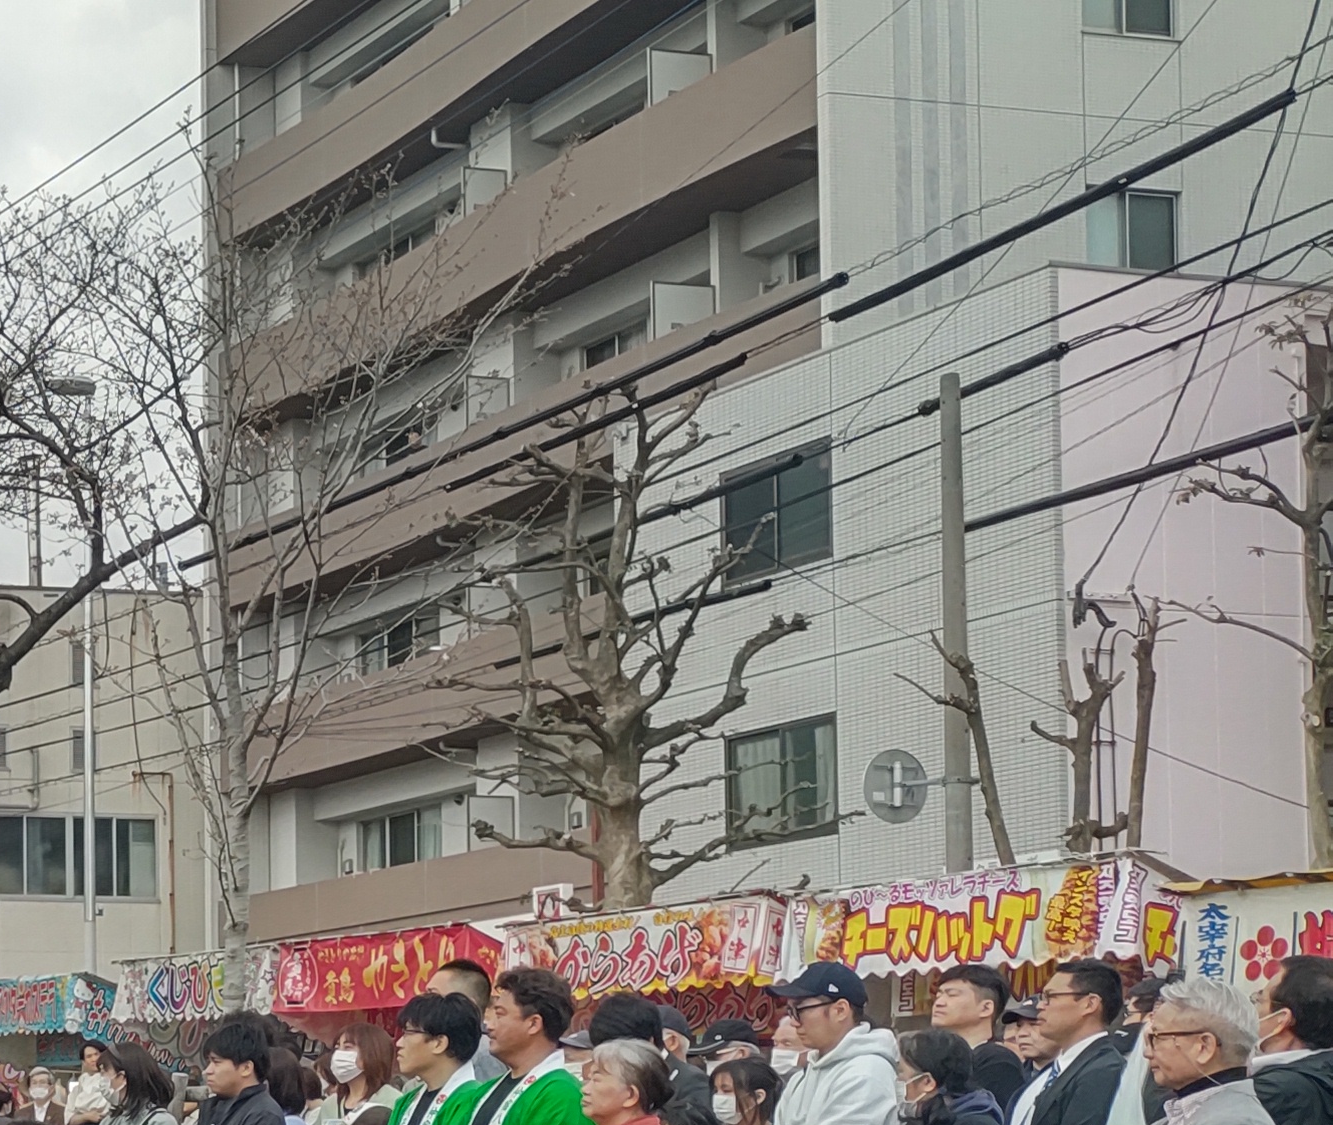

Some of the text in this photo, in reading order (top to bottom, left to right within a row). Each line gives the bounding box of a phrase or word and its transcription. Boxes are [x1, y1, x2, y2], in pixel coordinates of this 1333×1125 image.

[553, 920, 703, 994] からあげ
[728, 910, 750, 967] 中津
[841, 888, 1041, 970] チーズハットグ
[1195, 903, 1231, 981] 太宰府名
